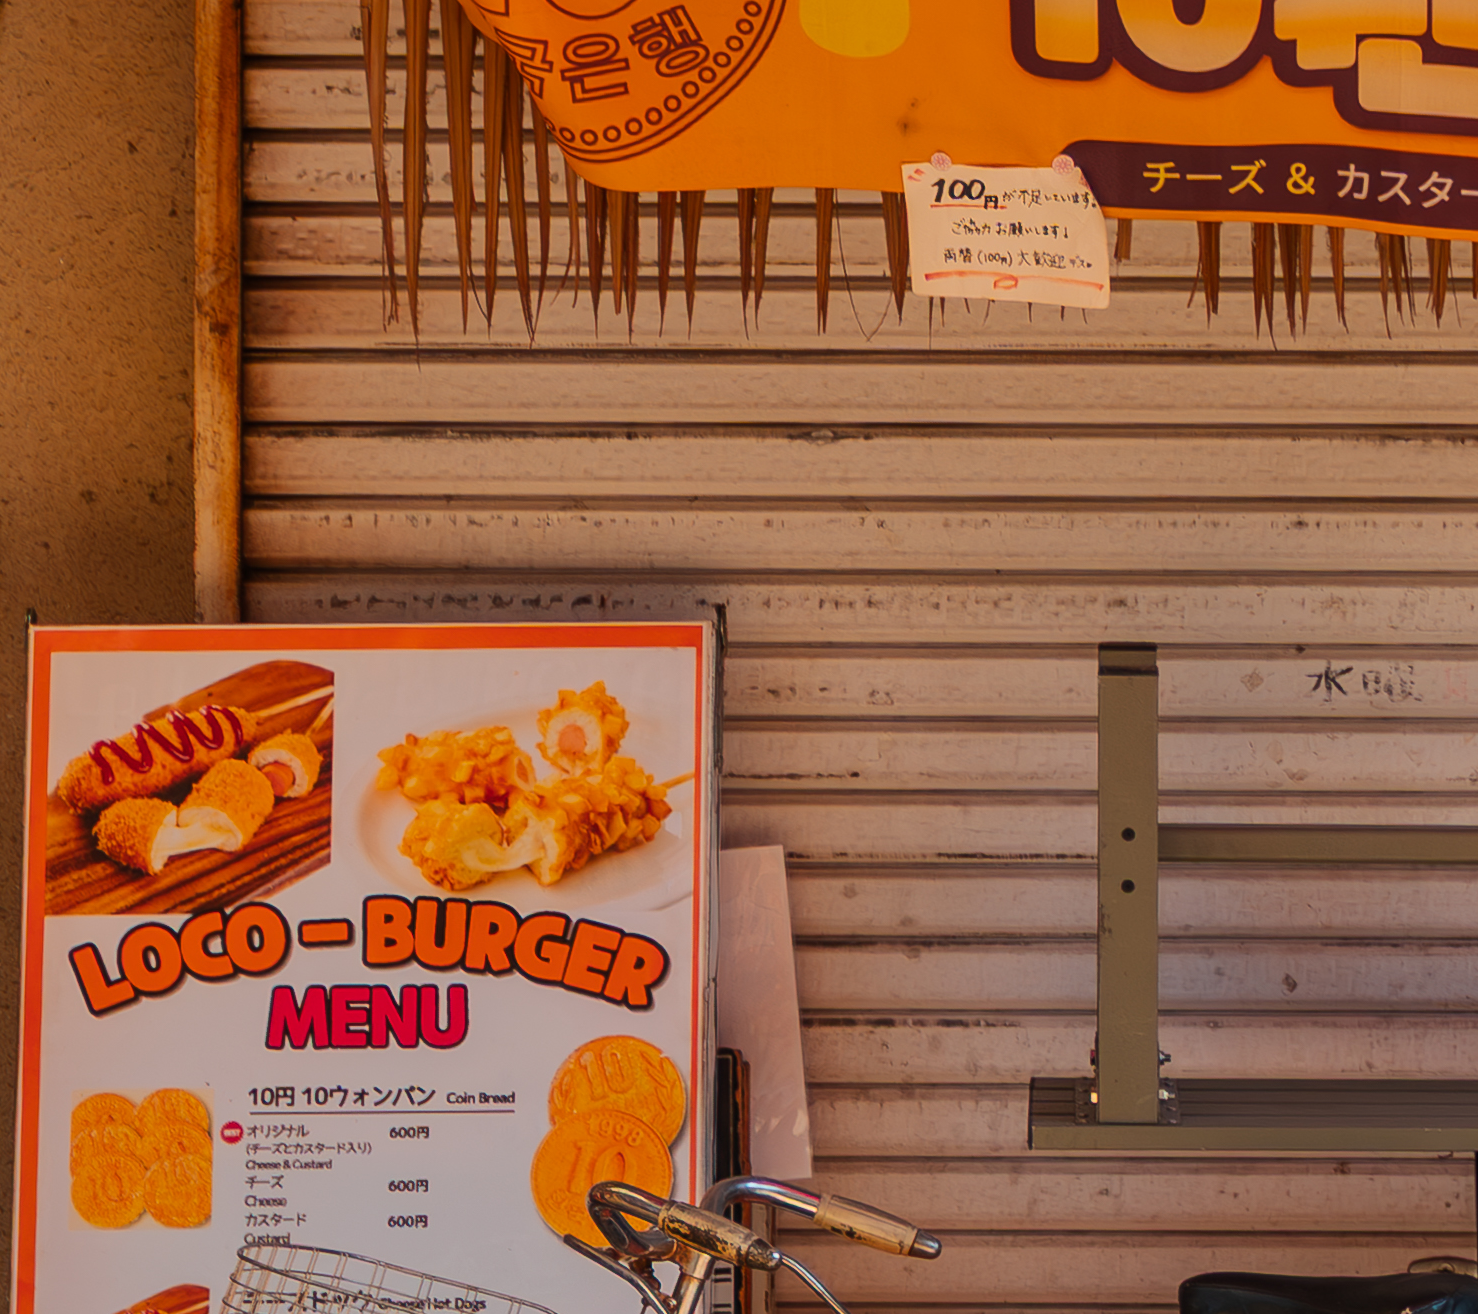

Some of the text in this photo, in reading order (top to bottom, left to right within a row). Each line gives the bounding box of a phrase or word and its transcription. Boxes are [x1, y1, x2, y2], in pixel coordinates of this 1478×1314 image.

[1142, 160, 1266, 197] チーズ
[1286, 162, 1317, 197] &
[68, 900, 291, 1017] LOCO
[362, 894, 671, 1012] BURGER
[266, 983, 469, 1051] MENU
[248, 1085, 515, 1108] 10円 10ウォンパン Coin Bread
[247, 1124, 430, 1140] オリジナル 600円
[245, 1159, 333, 1170] Cheese & Custard
[245, 1174, 429, 1193] チーズ 600円
[244, 1195, 288, 1207] Cheese
[245, 1213, 429, 1229] カスタード 600円
[455, 1297, 487, 1312] Dogs
